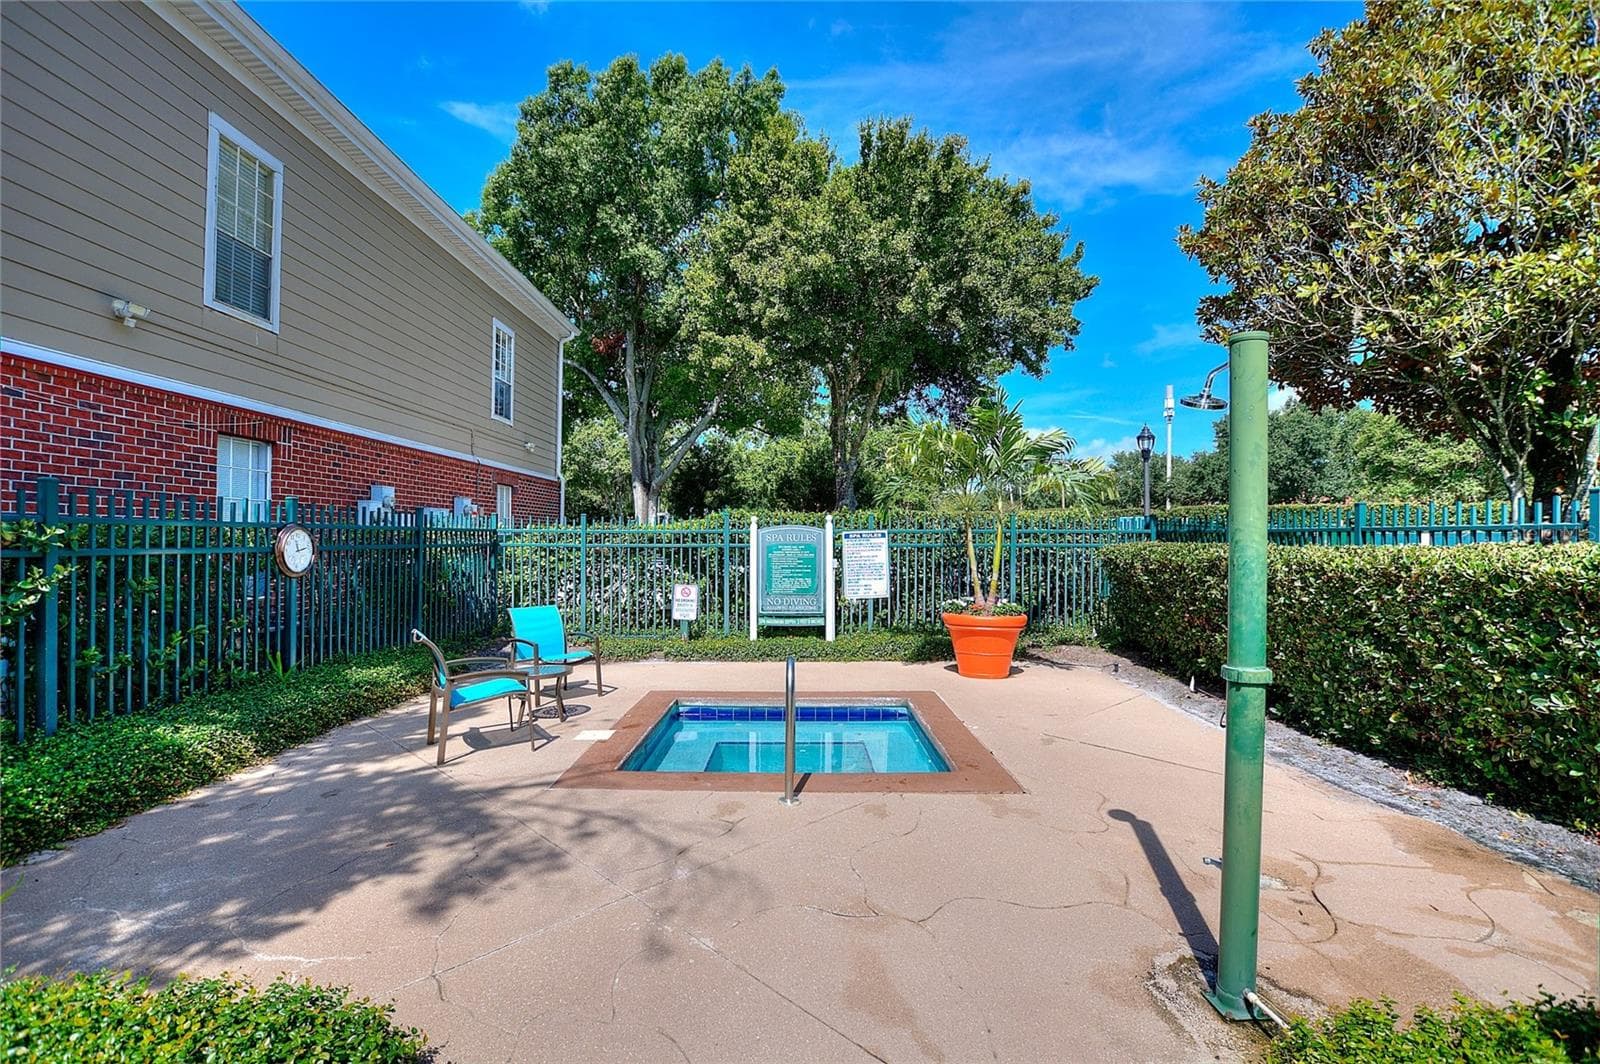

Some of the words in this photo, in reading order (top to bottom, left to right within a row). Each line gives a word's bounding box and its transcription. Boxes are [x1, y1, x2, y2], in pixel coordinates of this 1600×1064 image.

[766, 533, 783, 542] SPA
[786, 533, 817, 542] RULES
[767, 597, 781, 606] NO
[783, 597, 817, 606] DIVING
